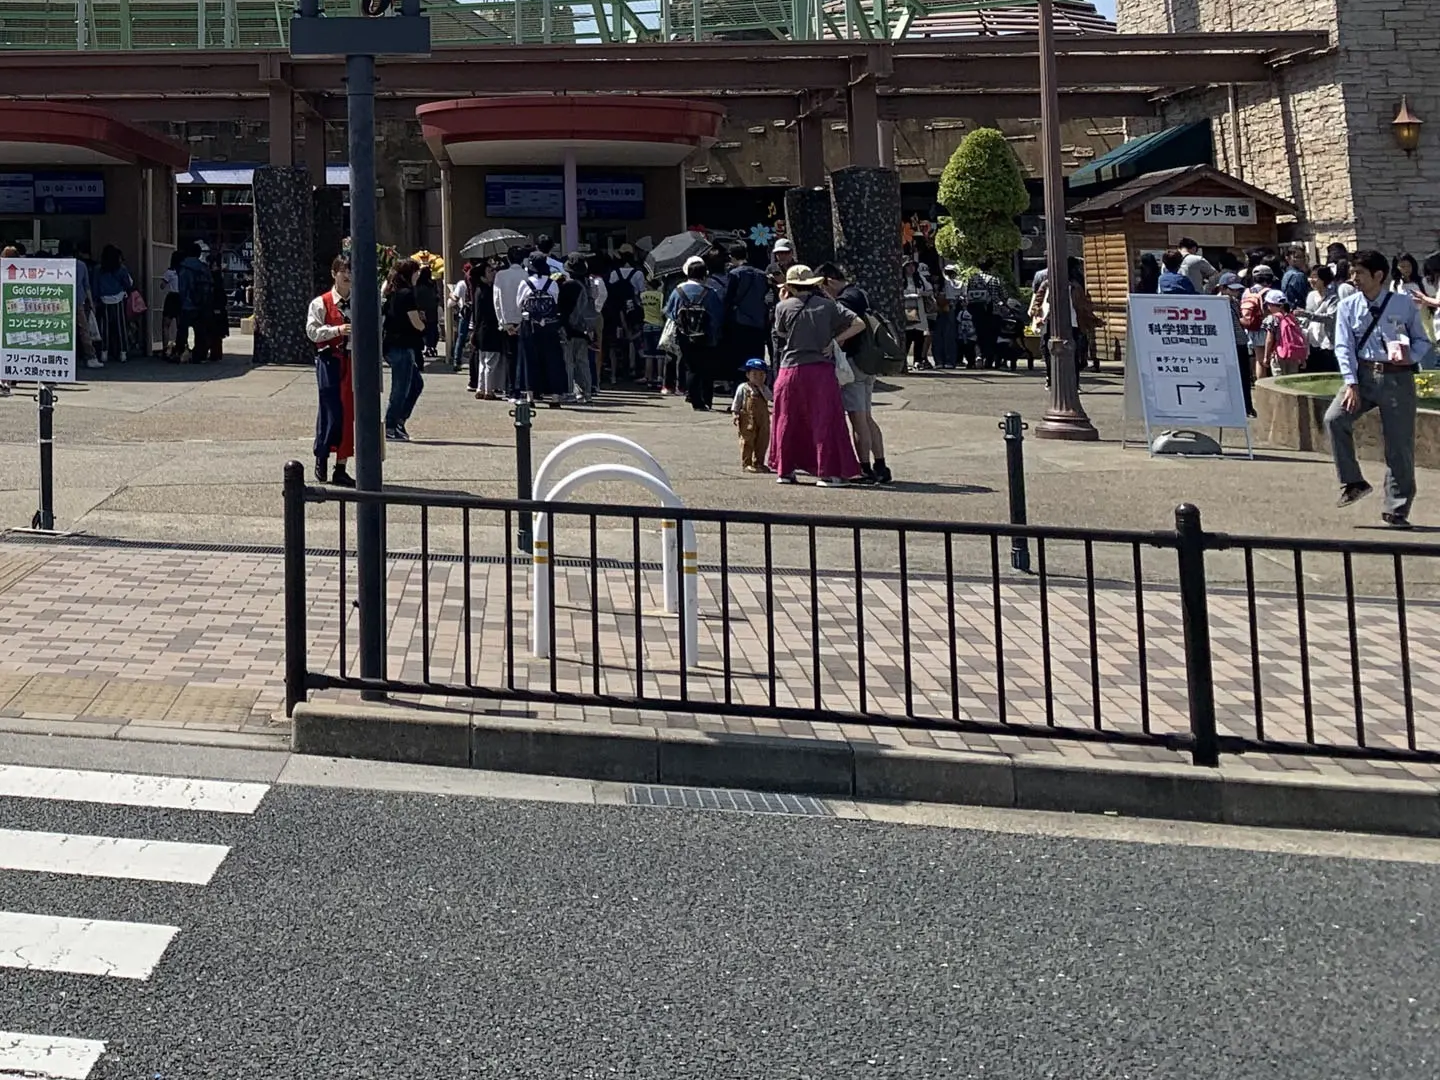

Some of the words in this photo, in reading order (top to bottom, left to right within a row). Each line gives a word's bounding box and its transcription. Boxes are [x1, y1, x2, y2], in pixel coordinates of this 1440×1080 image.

[1150, 203, 1250, 217] 臨時チケット売場
[8, 318, 68, 329] コンビニチケット
[1148, 322, 1218, 337] 科学捜査展
